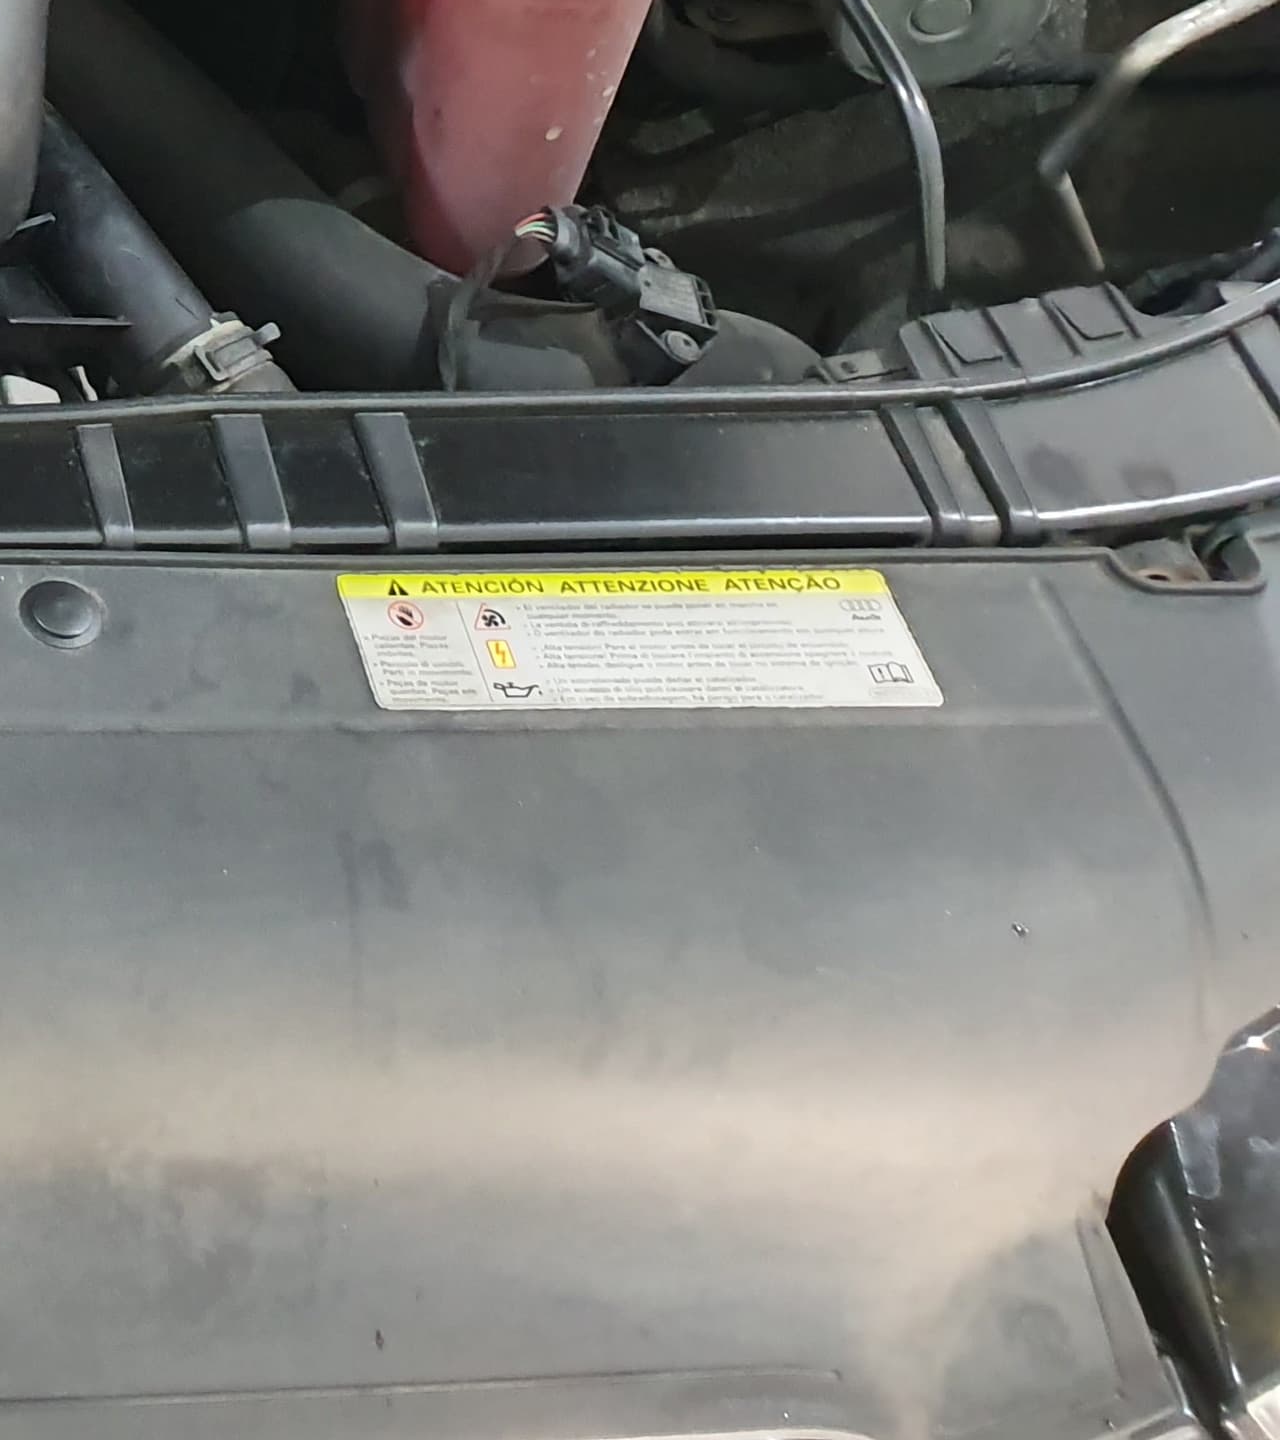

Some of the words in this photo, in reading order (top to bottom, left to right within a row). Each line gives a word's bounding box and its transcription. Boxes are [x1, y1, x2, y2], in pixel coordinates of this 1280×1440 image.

[421, 578, 545, 594] ATENCIÓN
[560, 578, 710, 594] ATTENZIONE
[723, 575, 841, 593] ATENÇÃO
